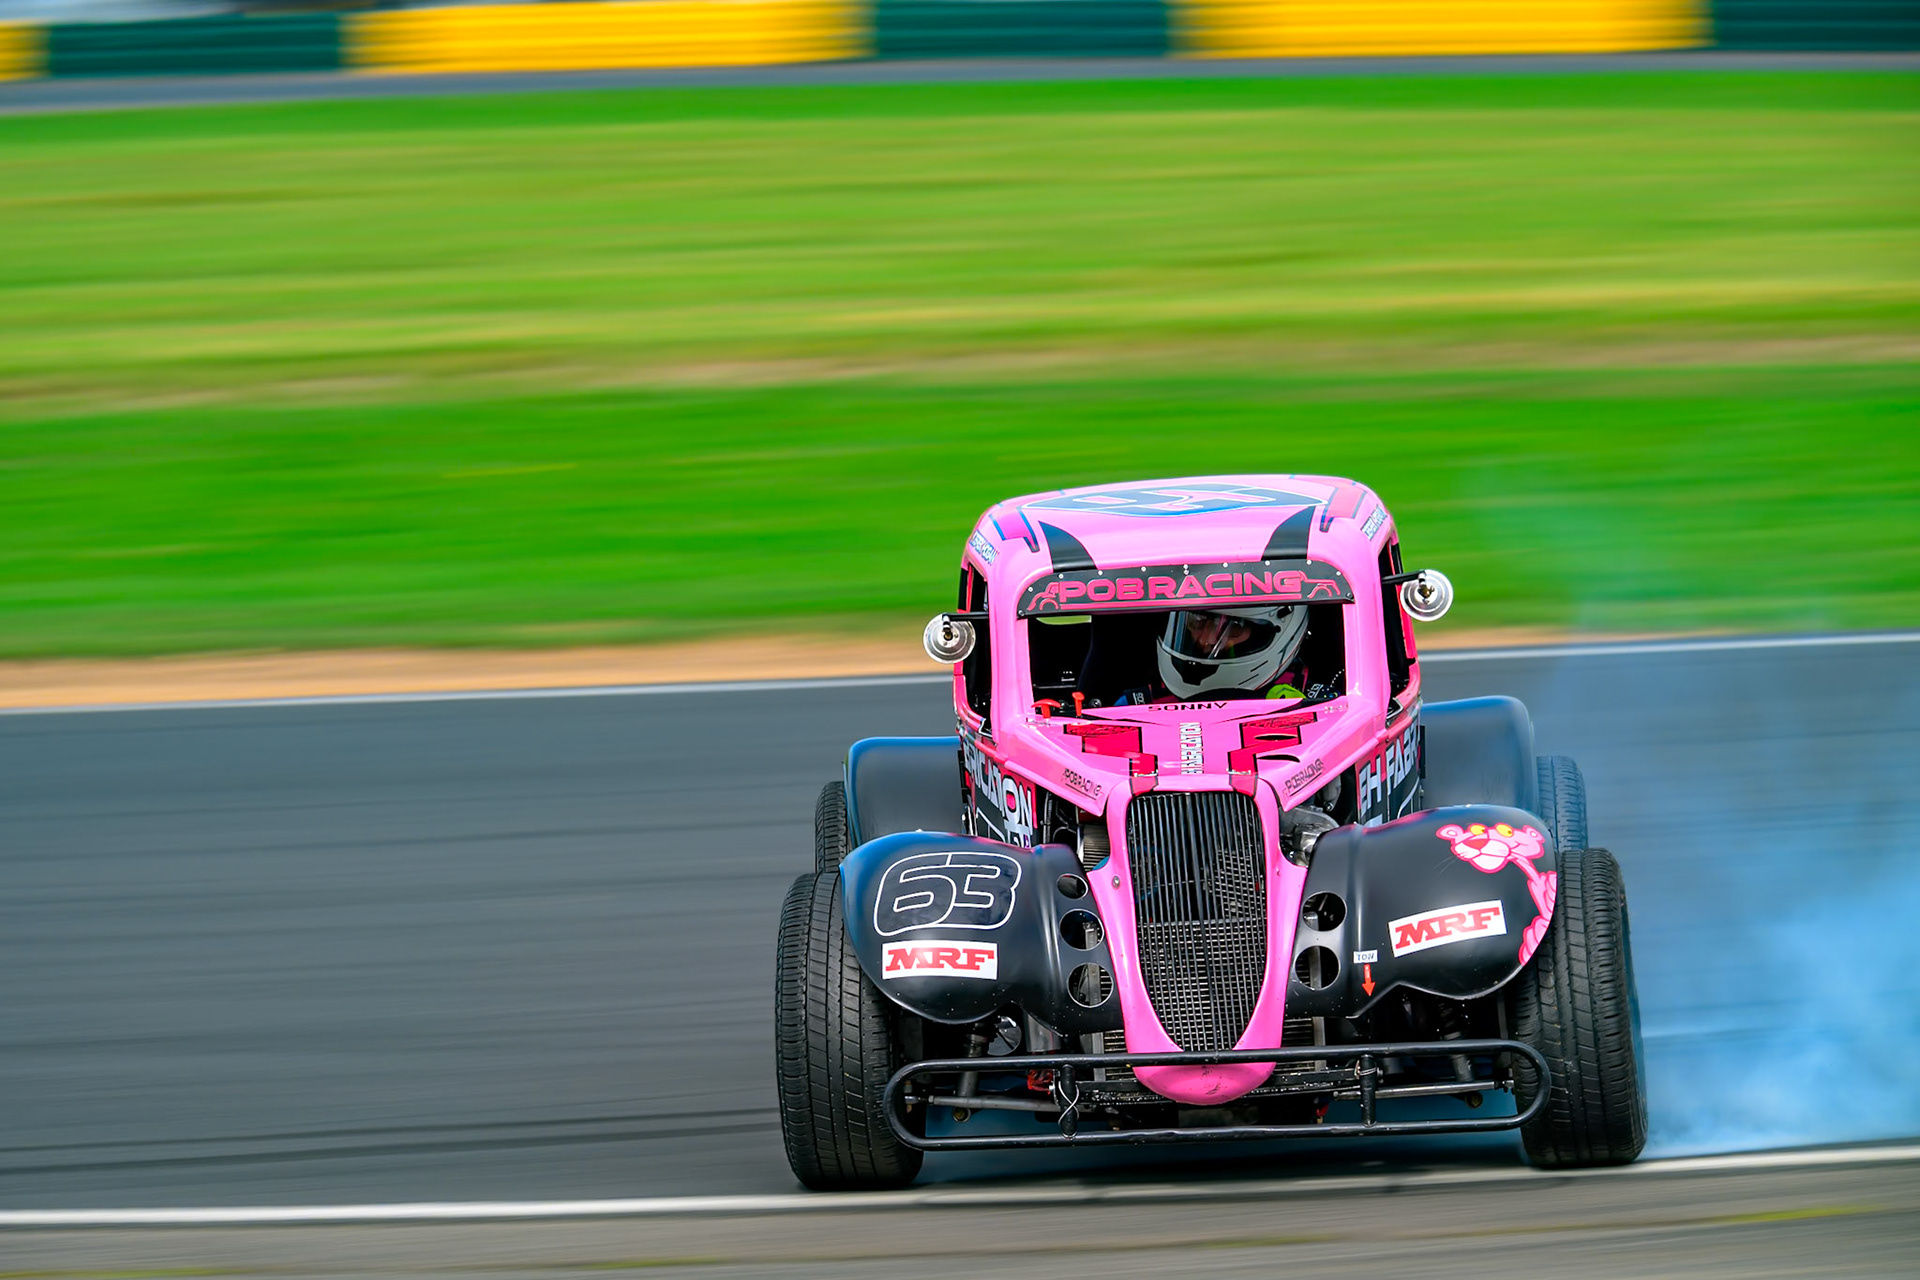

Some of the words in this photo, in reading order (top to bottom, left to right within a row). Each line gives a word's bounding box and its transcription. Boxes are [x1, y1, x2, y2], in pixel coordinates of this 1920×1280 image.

[874, 852, 1022, 936] 63
[1395, 907, 1500, 949] MRF
[885, 947, 994, 971] MRF
[1356, 953, 1375, 961] TOW
